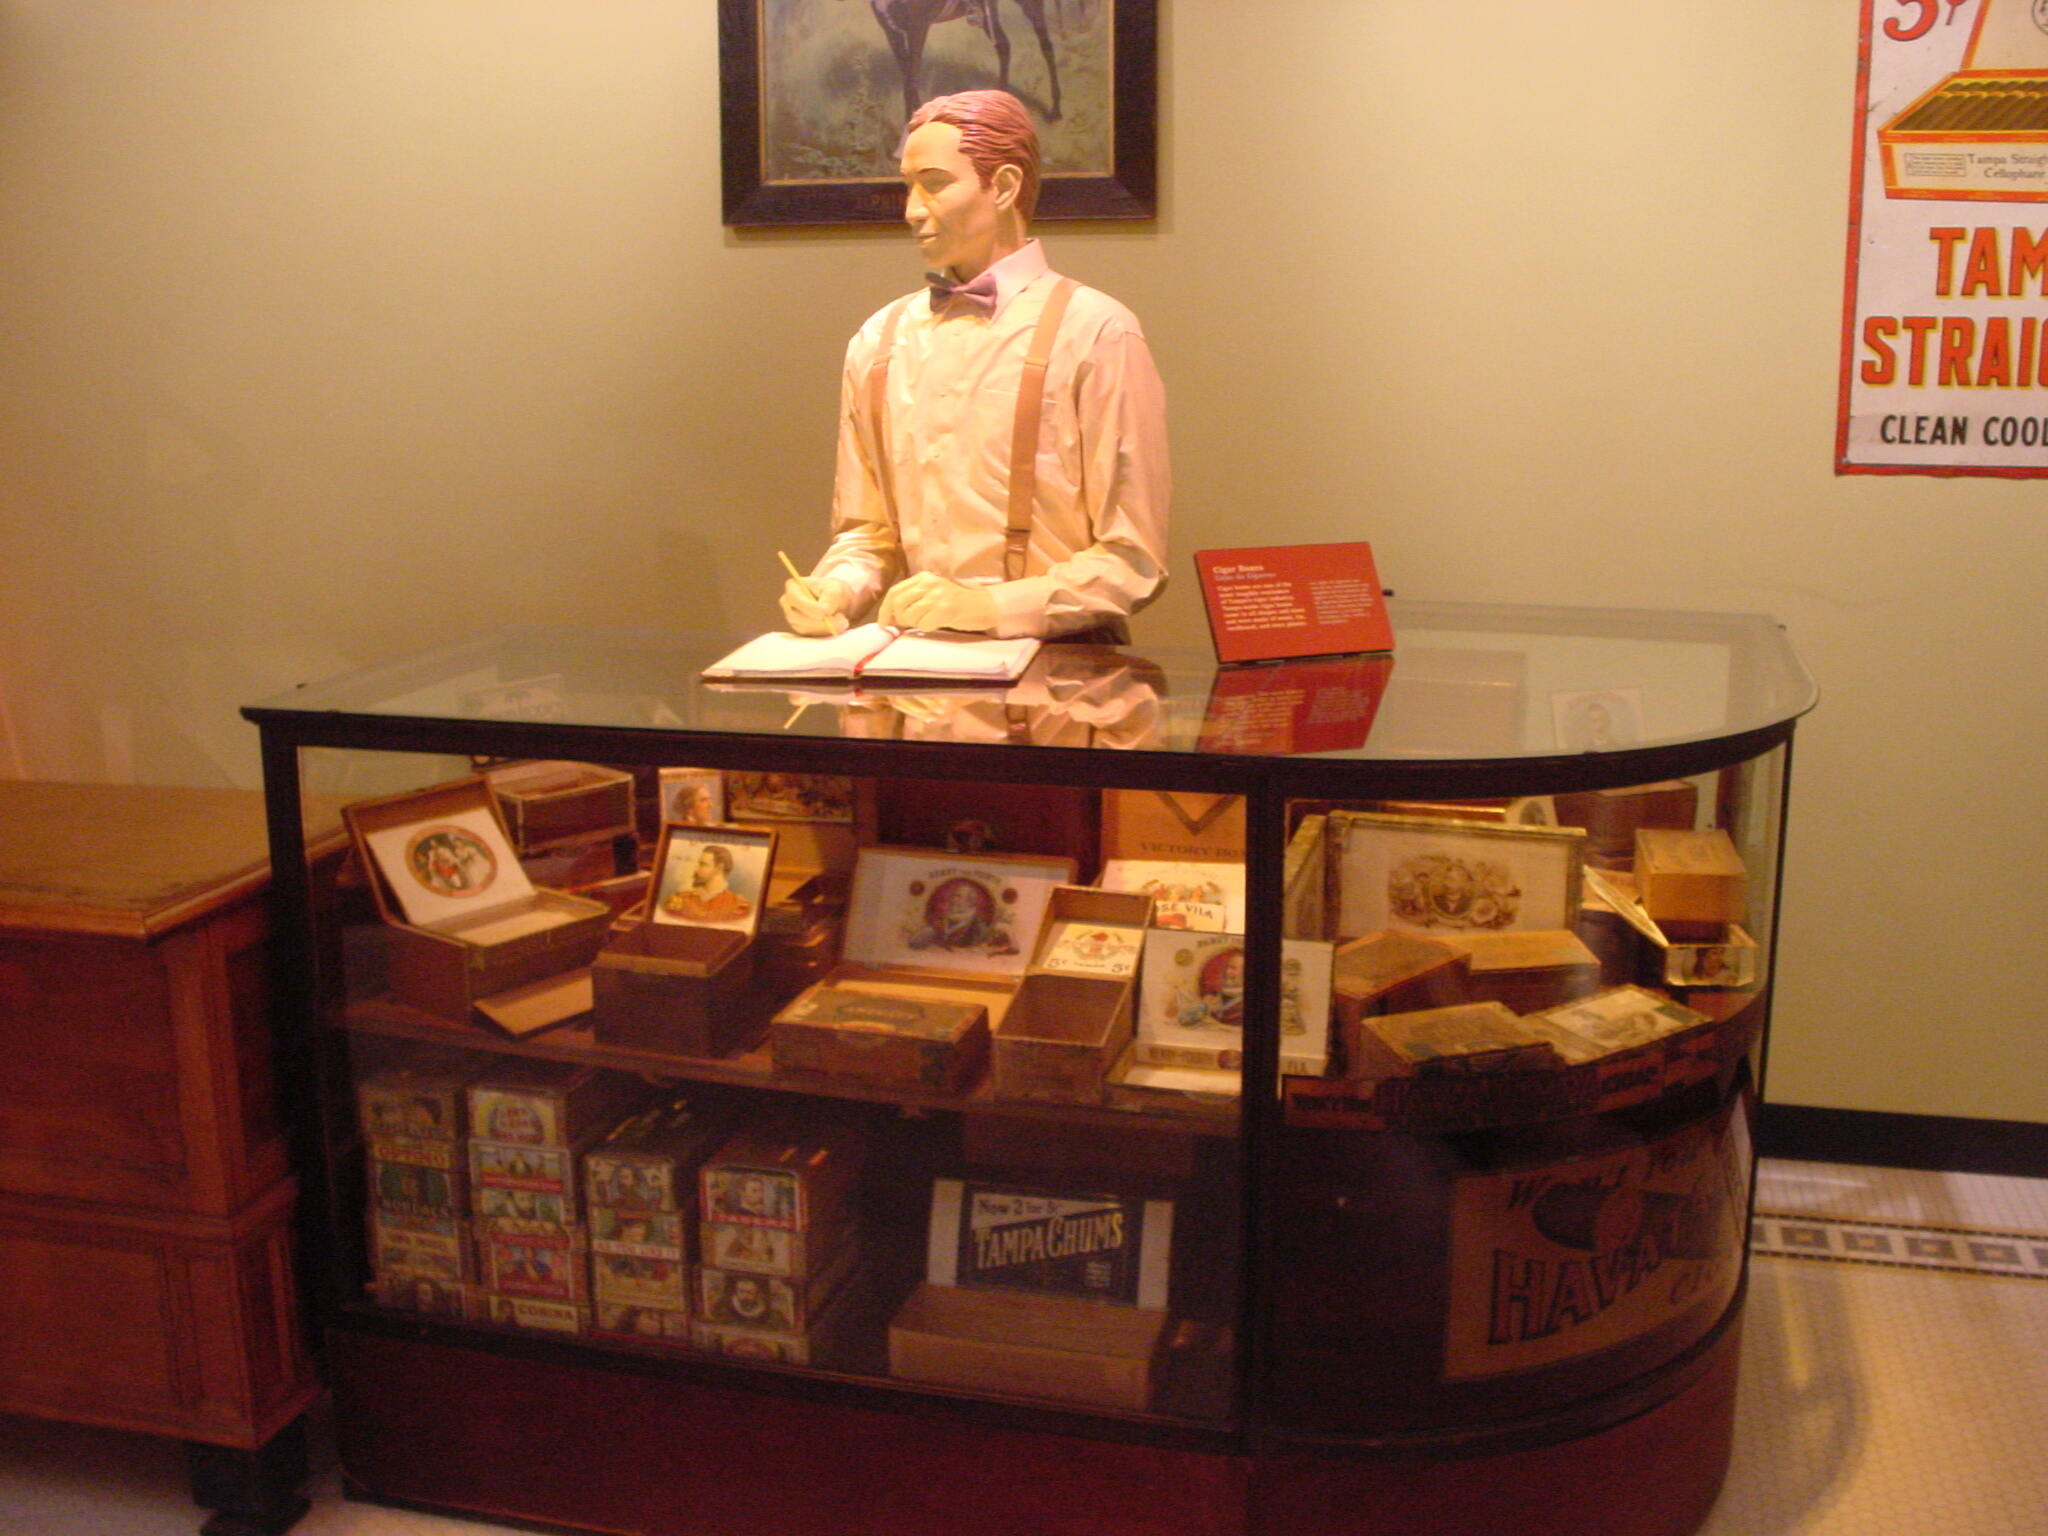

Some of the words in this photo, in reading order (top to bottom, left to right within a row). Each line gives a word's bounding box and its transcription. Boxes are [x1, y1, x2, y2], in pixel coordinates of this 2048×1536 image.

[1930, 227, 2048, 297] TAM
[1880, 414, 1968, 445] CLEAN
[976, 1224, 1046, 1270] TAMPA
